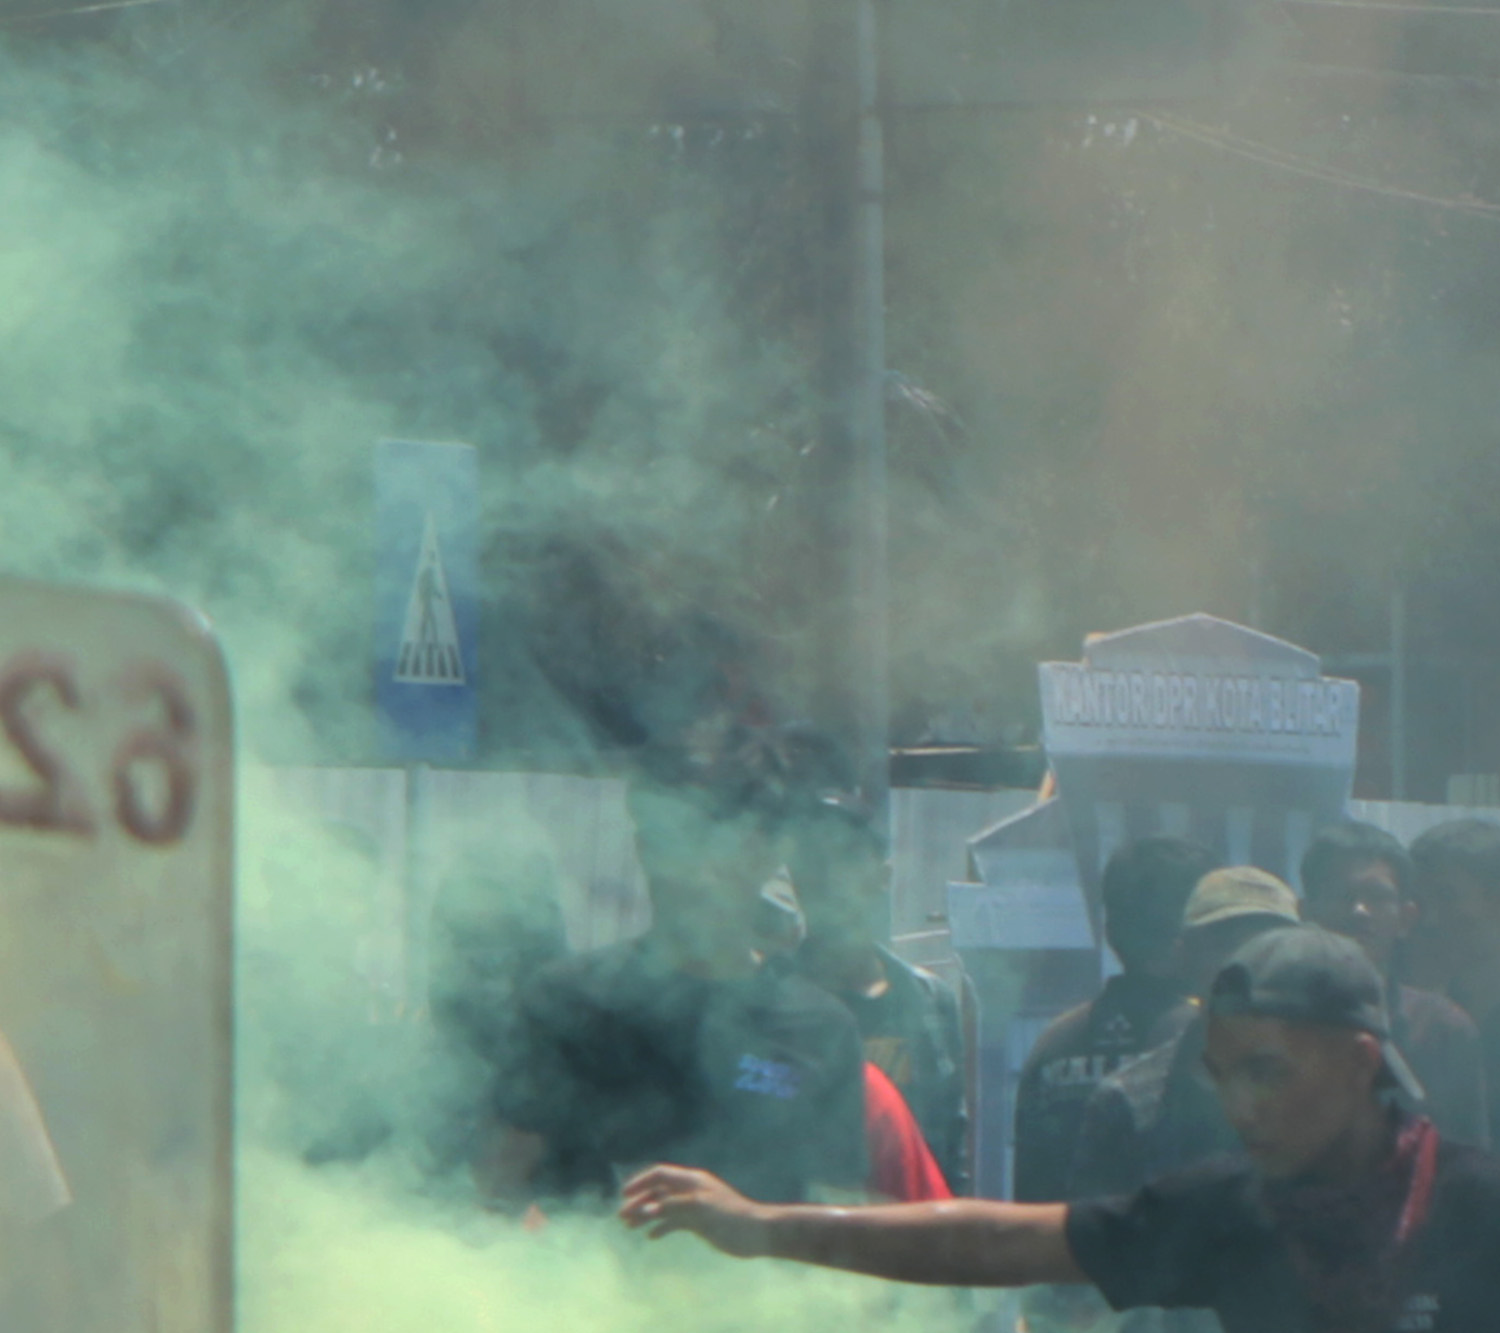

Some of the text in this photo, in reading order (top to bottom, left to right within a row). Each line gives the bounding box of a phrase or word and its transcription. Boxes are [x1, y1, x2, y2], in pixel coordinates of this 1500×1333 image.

[1052, 669, 1341, 737] KANTOR DPR KOTA BLITAR
